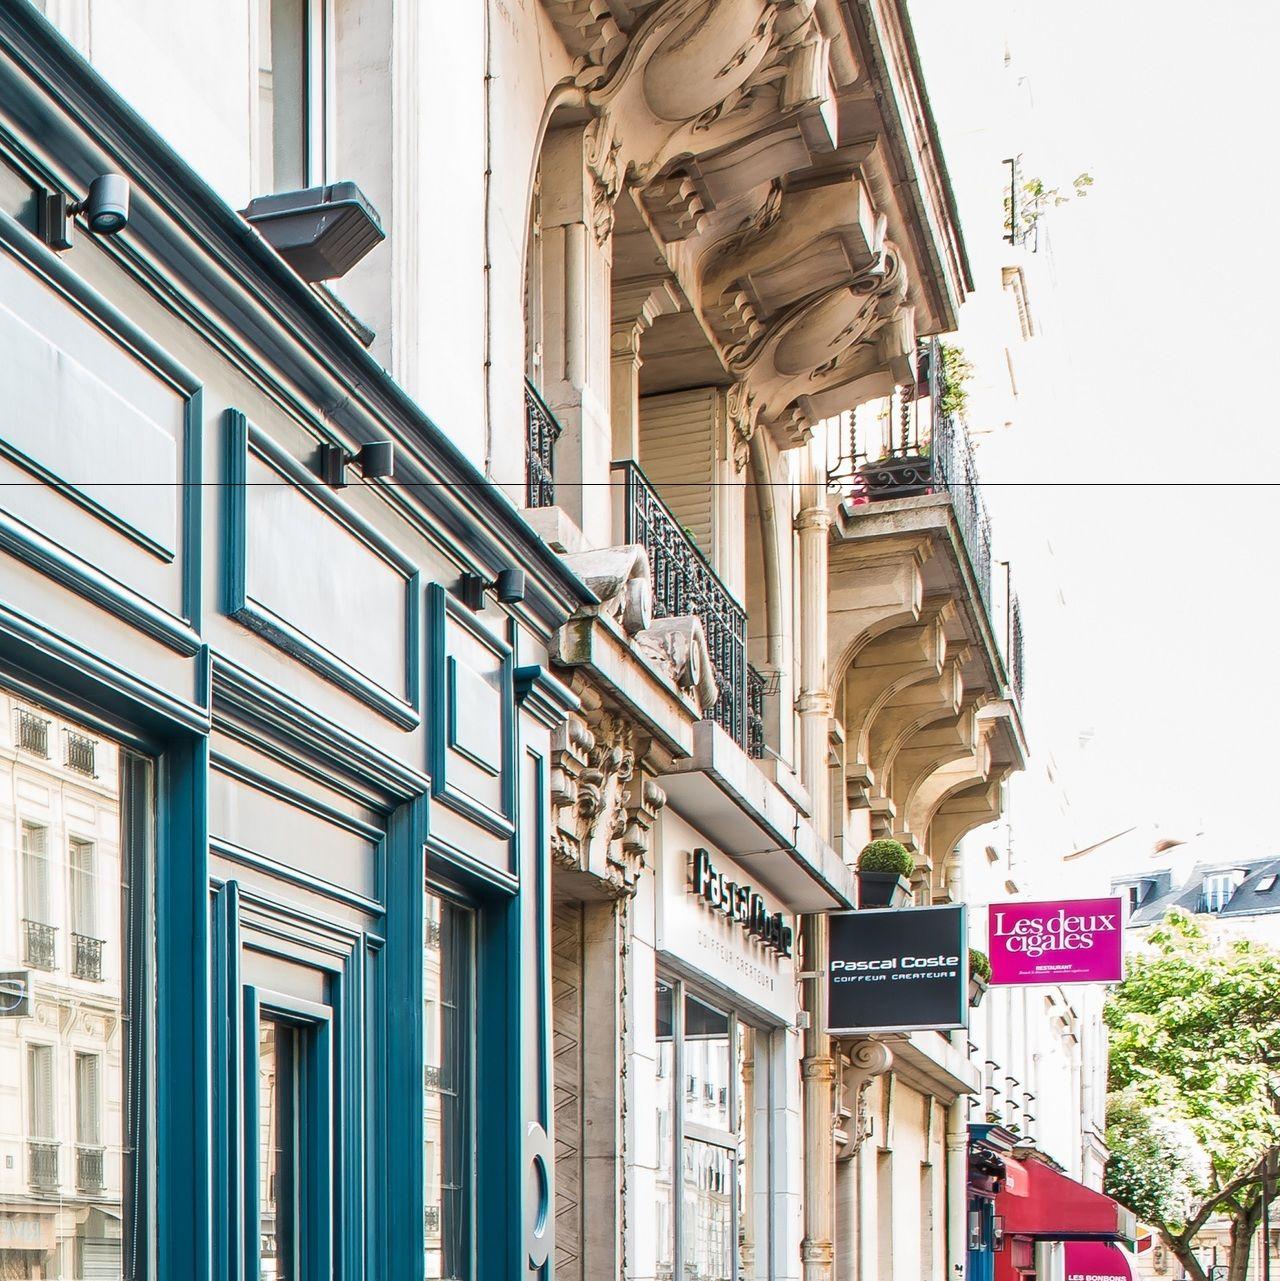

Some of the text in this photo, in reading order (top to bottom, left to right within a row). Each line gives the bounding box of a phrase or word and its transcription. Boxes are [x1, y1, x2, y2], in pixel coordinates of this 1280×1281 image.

[693, 848, 751, 928] Pascal
[994, 909, 1116, 936] Les deux
[1006, 928, 1094, 958] cigales
[831, 955, 959, 971] Pascal Coste
[834, 971, 948, 983] COIFFEUR CREATEUR
[1068, 1274, 1127, 1281] LES BONBONS
